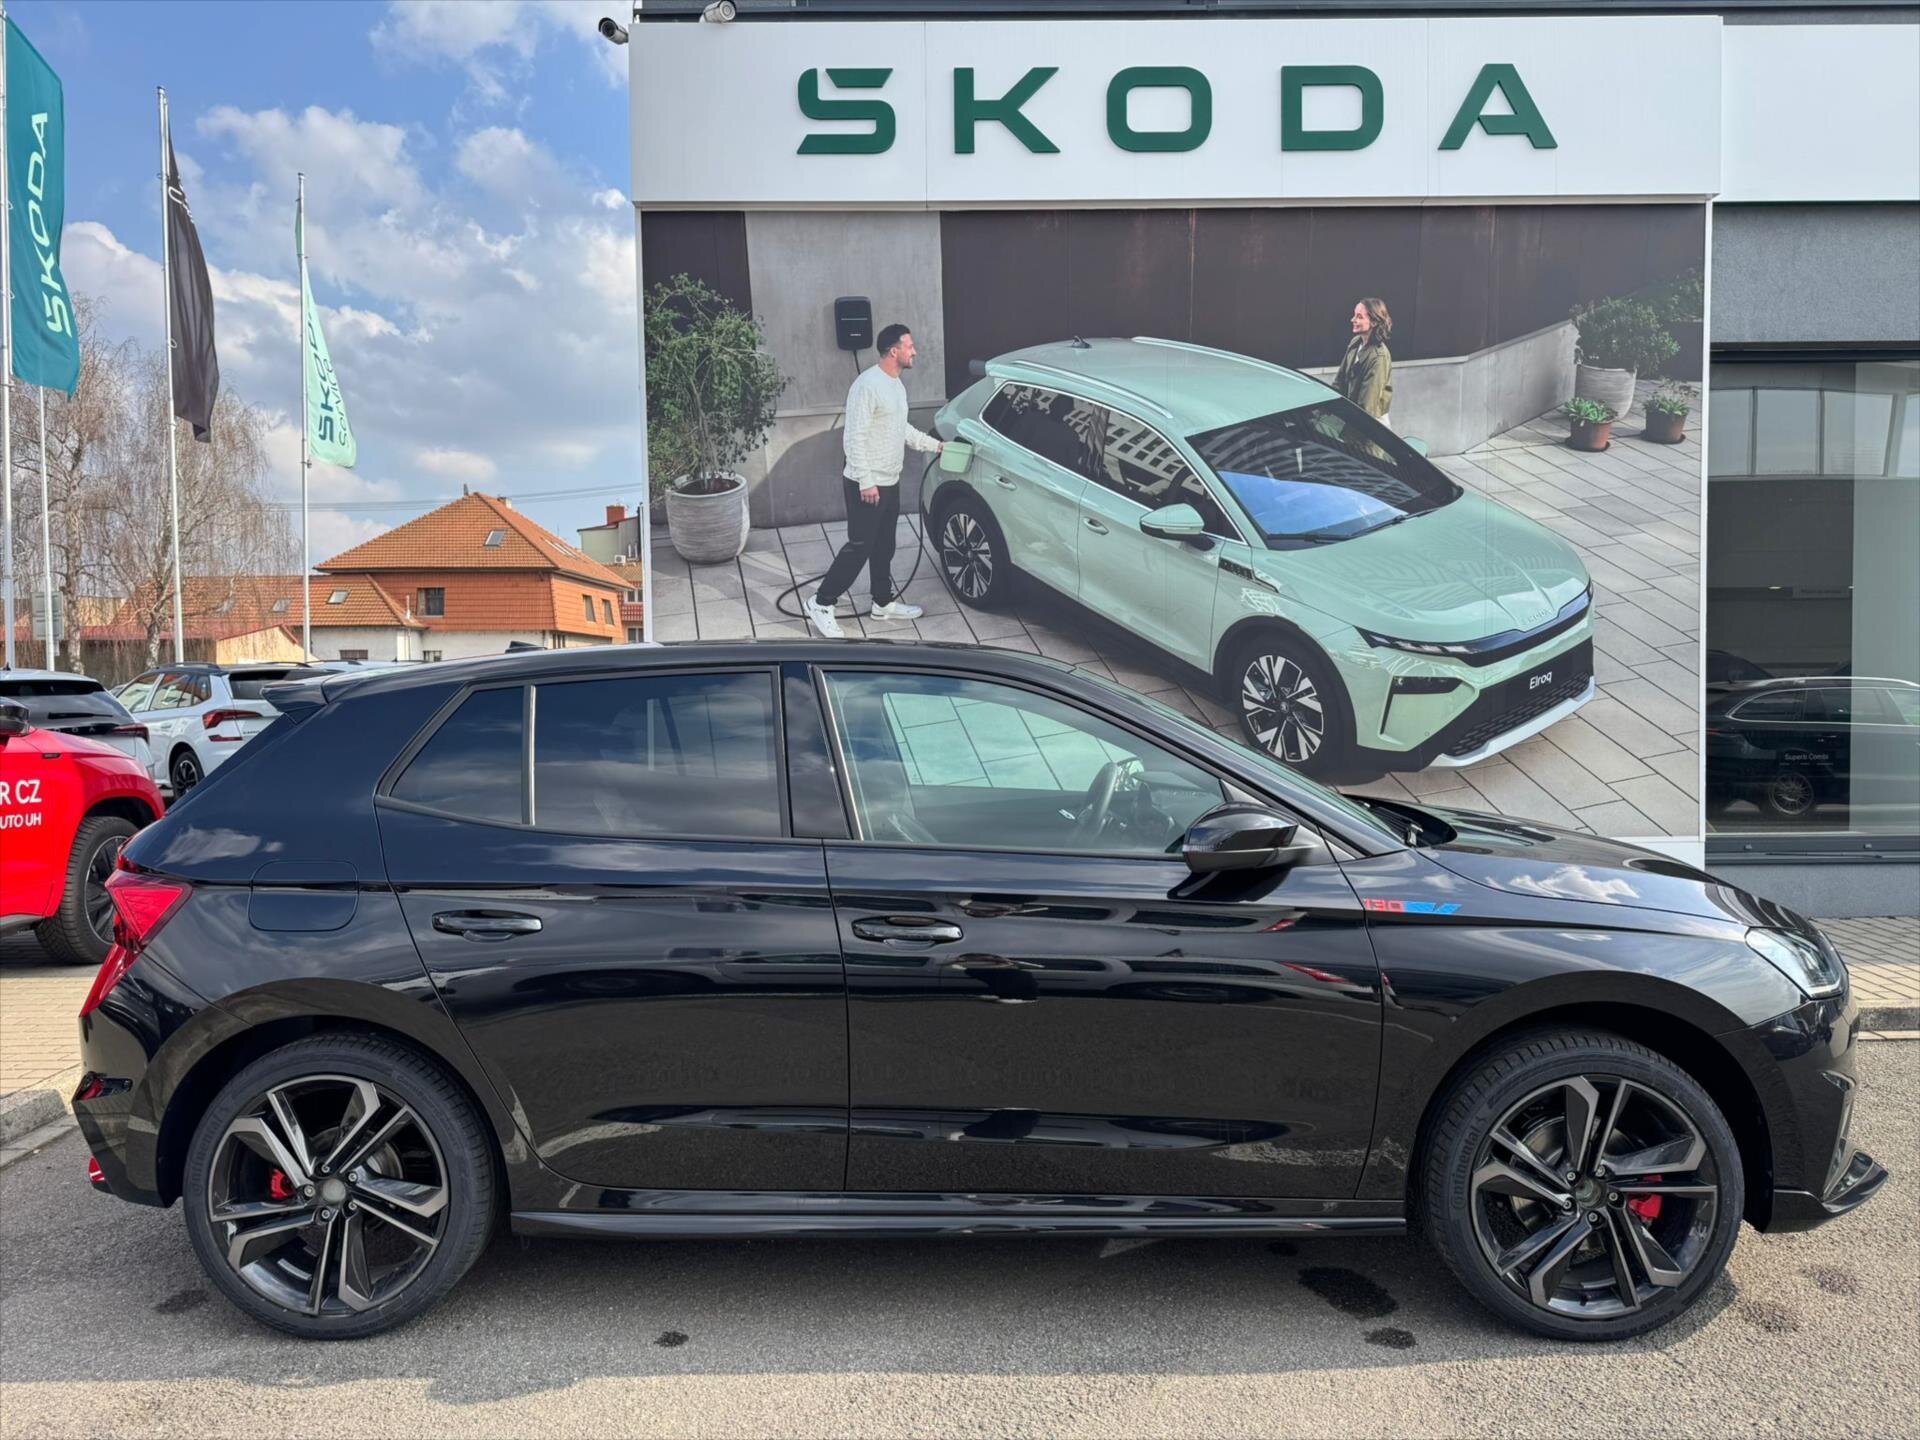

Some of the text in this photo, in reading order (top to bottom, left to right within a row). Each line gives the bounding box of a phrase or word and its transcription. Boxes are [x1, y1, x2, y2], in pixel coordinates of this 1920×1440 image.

[1529, 671, 1552, 690] Elroq
[15, 779, 42, 805] CZ
[25, 812, 42, 827] UH
